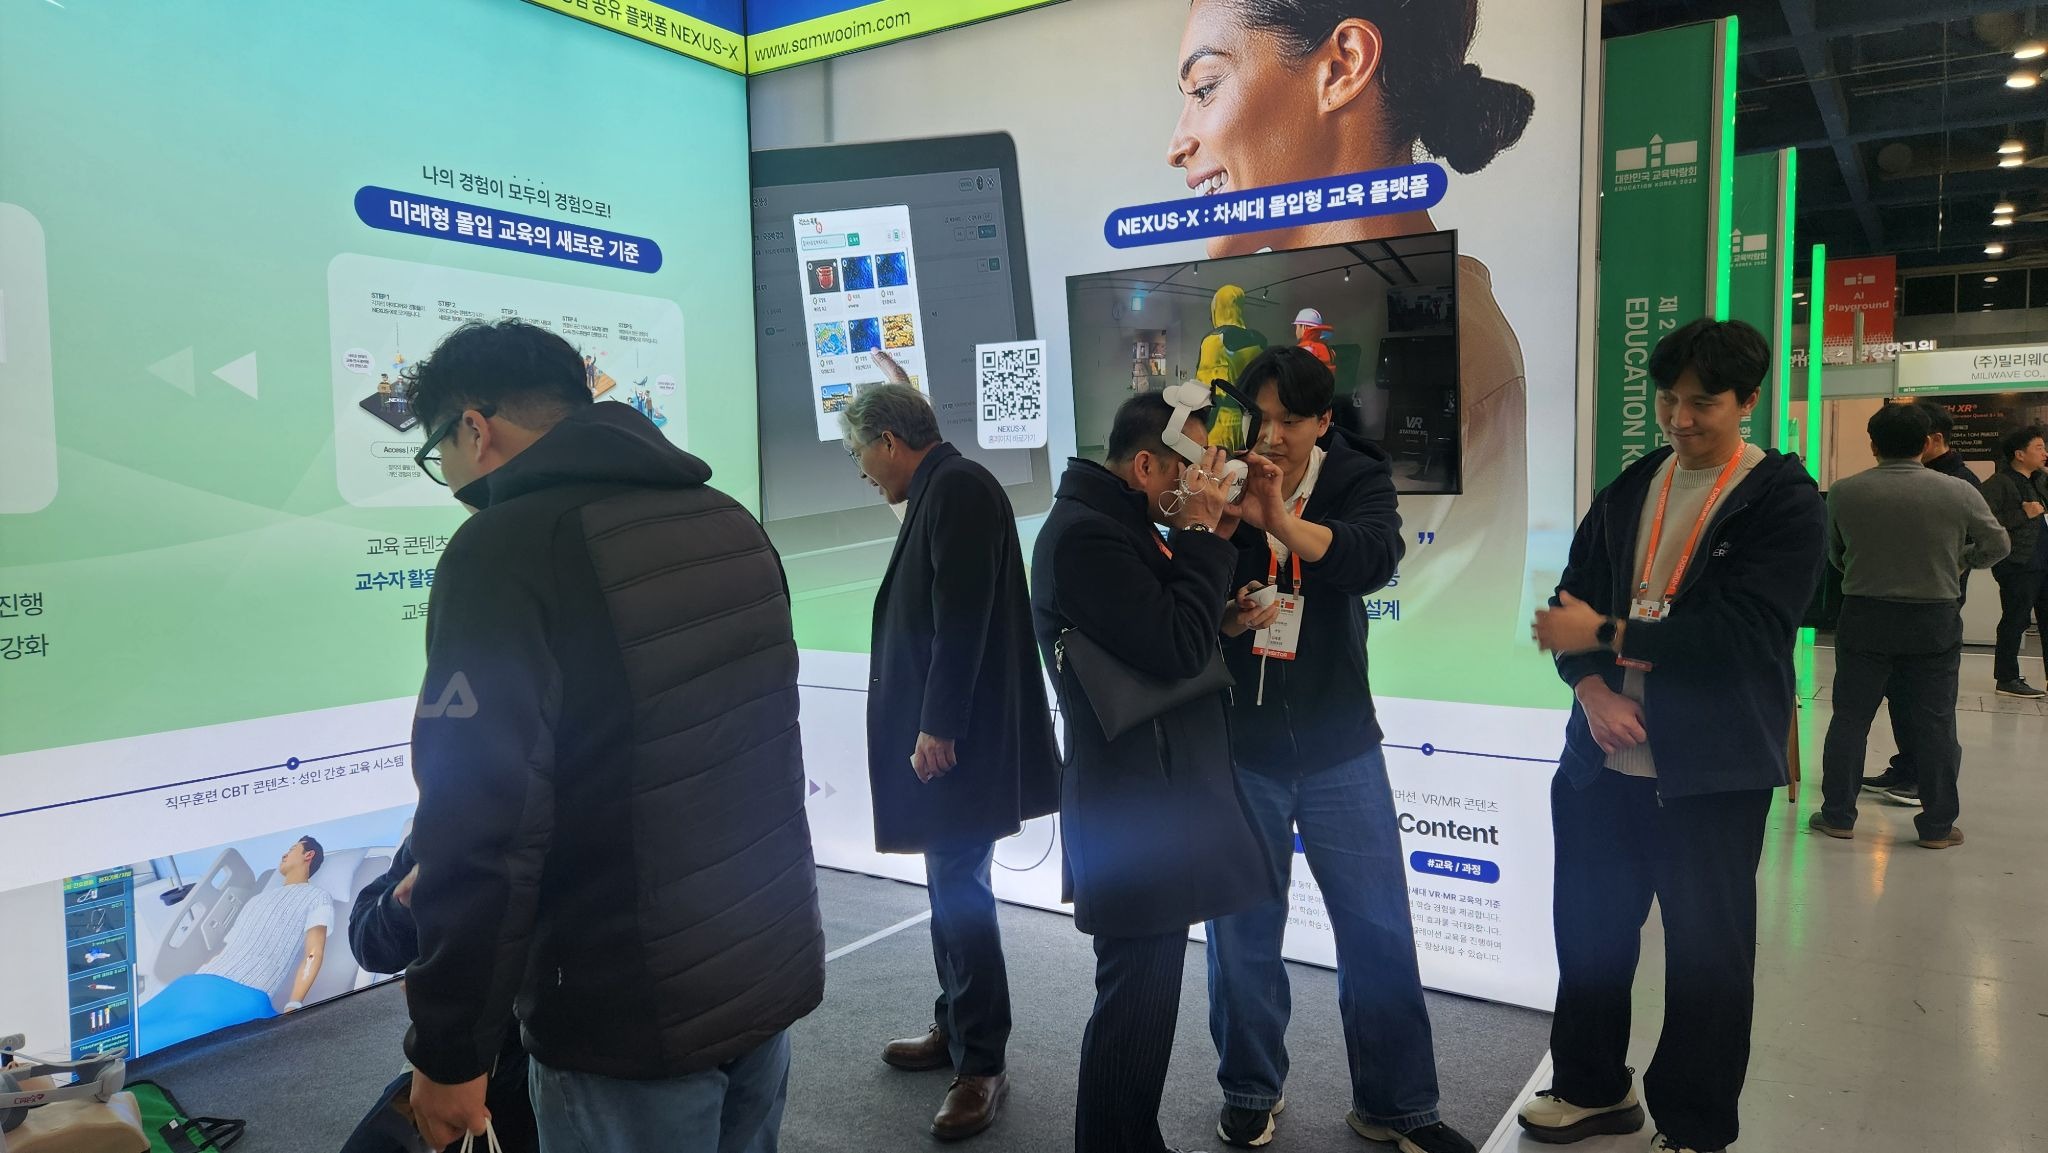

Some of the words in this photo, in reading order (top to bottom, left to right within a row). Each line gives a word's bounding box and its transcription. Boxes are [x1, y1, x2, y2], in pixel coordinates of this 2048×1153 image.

[625, 5, 667, 37] 플랫폼
[671, 22, 739, 61] NEXUS-X
[755, 10, 911, 62] www.samwooim.com
[1615, 171, 1650, 185] 대한민국
[1652, 166, 1697, 180] 교육박람회
[422, 165, 454, 188] 나의
[459, 172, 504, 198] 경험이
[508, 179, 550, 208] 모두의
[554, 192, 612, 219] 경험으로!
[1614, 183, 1652, 192] EDUCATION
[1117, 209, 1199, 237] NEXUS-X
[1213, 198, 1264, 224] 차세대
[1268, 189, 1322, 219] 몰입형
[1327, 184, 1364, 209] 교육
[1369, 174, 1429, 204] 플랫폼
[389, 199, 450, 232] 미래형
[455, 210, 493, 239] 몰입
[498, 219, 551, 249] 교육의
[555, 230, 605, 258] 새로운
[608, 239, 640, 264] 기준
[1854, 291, 1864, 300] AI
[1828, 301, 1889, 312] Playground
[1622, 297, 1649, 437] EDUCATION
[1971, 370, 2021, 380] MILIWAVE
[1406, 416, 1423, 429] VR
[383, 446, 406, 454] Access
[367, 537, 400, 556] 교육
[403, 536, 449, 555] 콘텐츠
[355, 570, 405, 591] 교수자
[0, 592, 43, 617] 진행
[1366, 599, 1400, 621] 설계
[0, 633, 49, 660] 강화
[165, 788, 218, 810] 직무훈련
[221, 783, 250, 800] CBT
[252, 777, 290, 794] 콘텐츠
[298, 769, 321, 786] 성인
[324, 764, 346, 781] 간호
[348, 761, 370, 777] 교육
[372, 754, 404, 771] 시스템
[1421, 793, 1461, 808] VR/MR
[1398, 812, 1499, 845] Content
[1427, 858, 1453, 871] #교육
[1462, 863, 1481, 876] 과정
[1434, 903, 1456, 915] 경험을
[1459, 895, 1482, 905] 교육의
[1485, 899, 1501, 909] 기준
